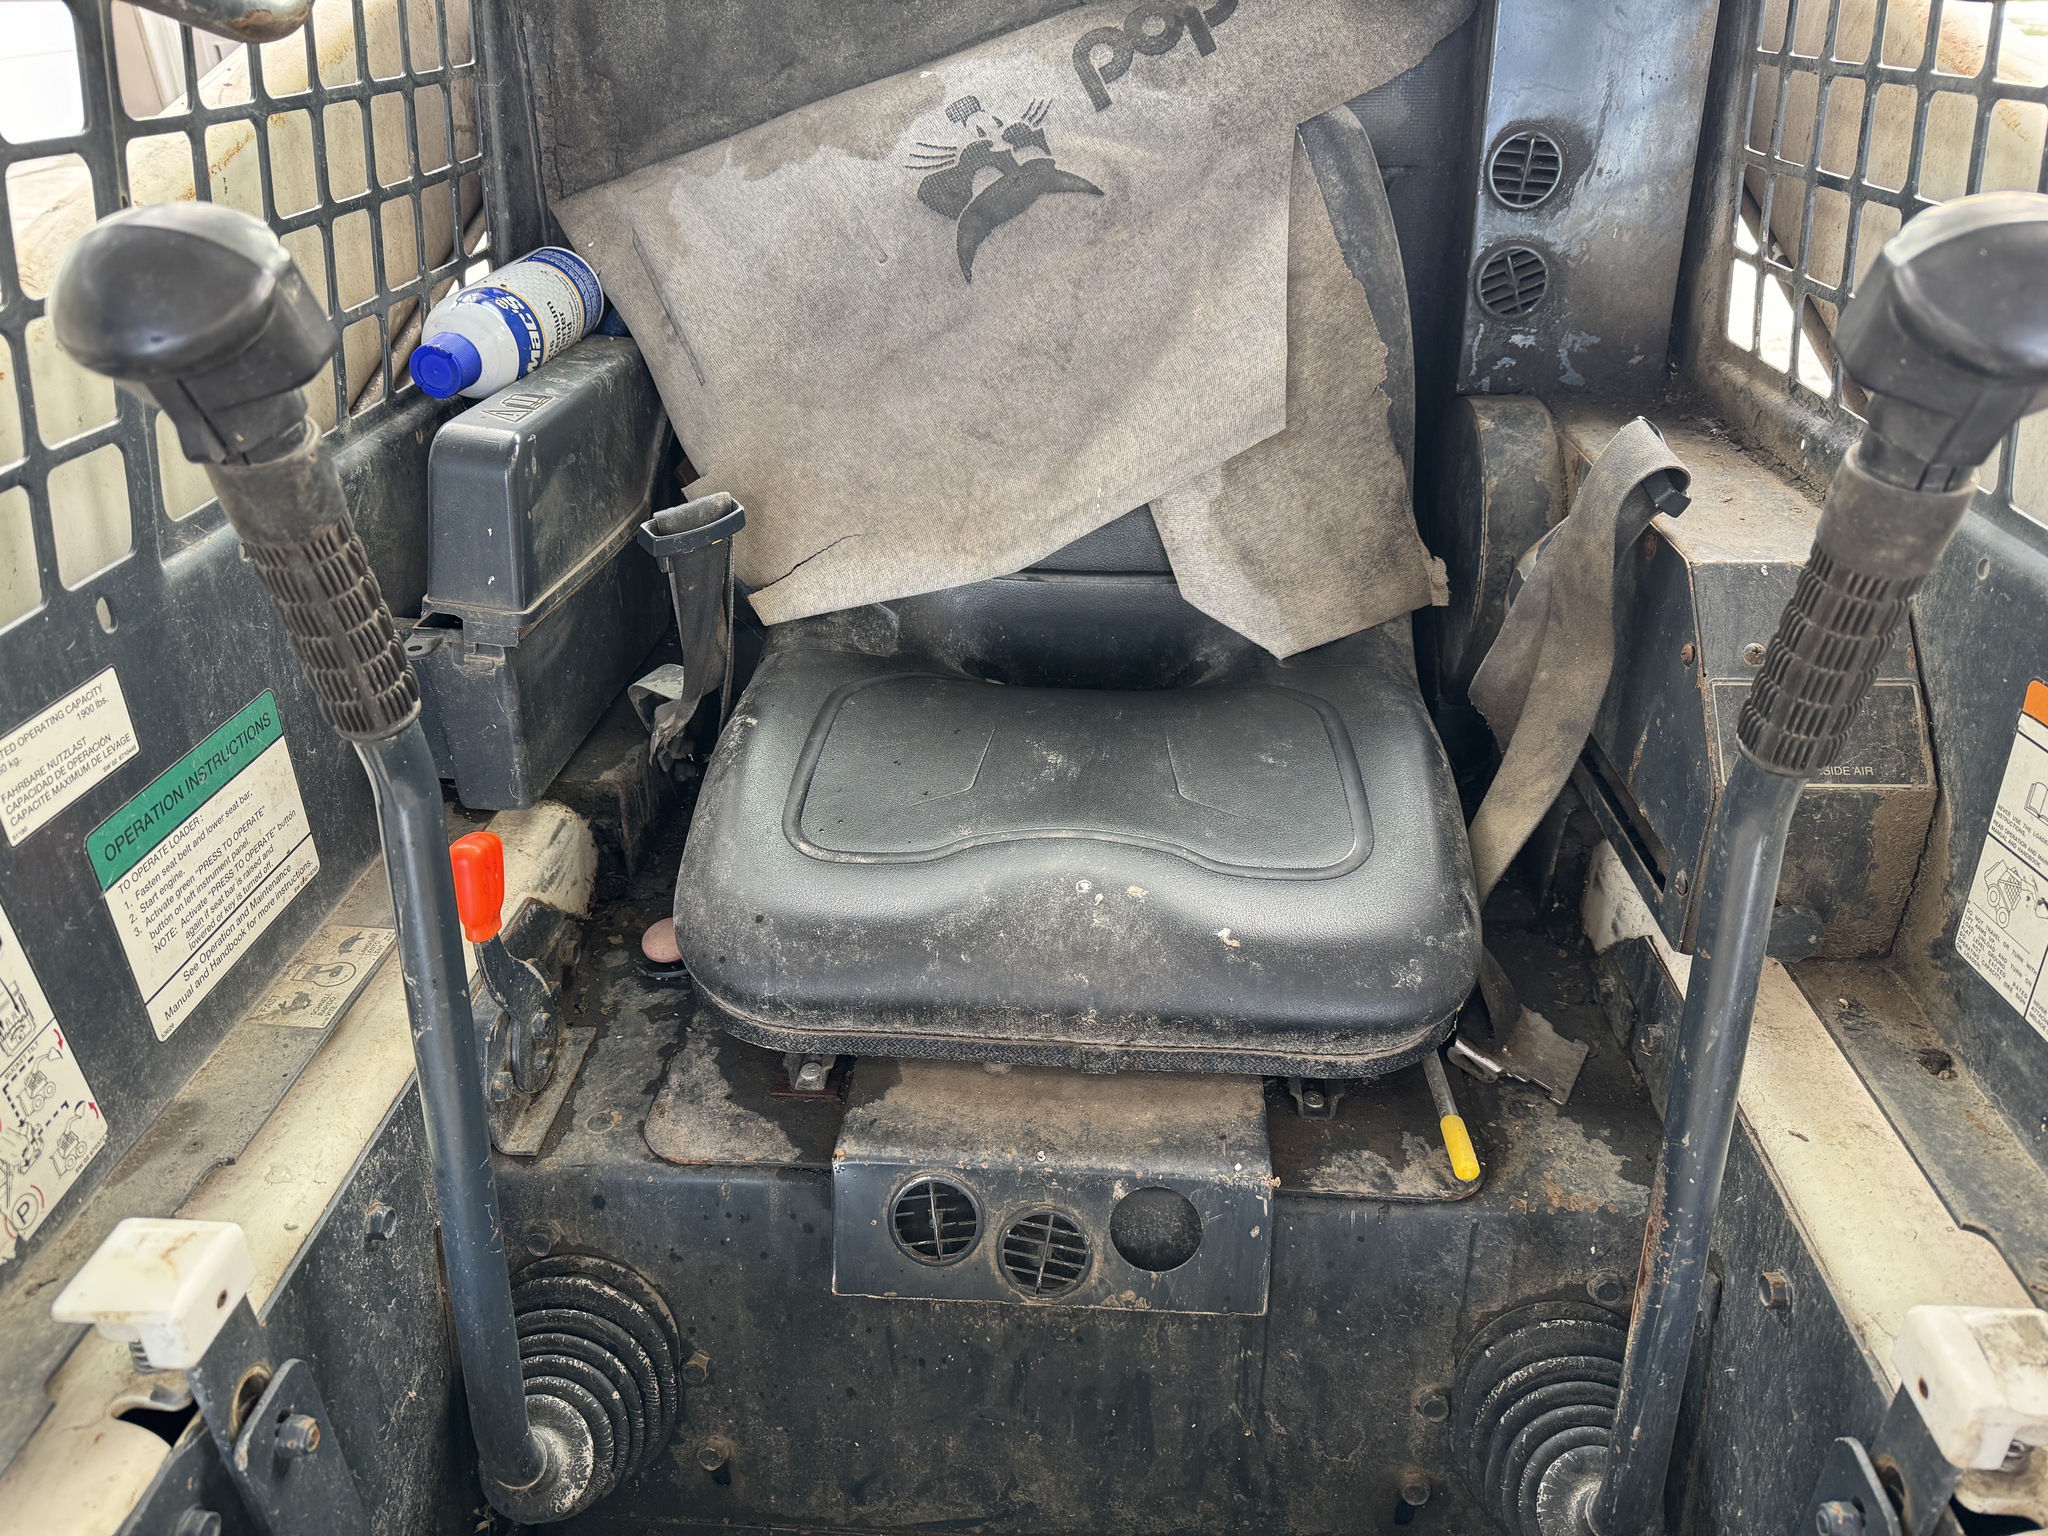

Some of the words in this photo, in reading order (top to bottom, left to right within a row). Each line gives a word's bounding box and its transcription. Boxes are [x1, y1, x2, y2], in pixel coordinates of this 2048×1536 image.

[18, 709, 64, 747] OPERATING
[66, 684, 103, 714] CAPACITY
[77, 704, 95, 721] 1900
[95, 698, 108, 711] lbs.
[1, 764, 51, 803] FAHRBARE
[48, 736, 87, 771] NUTZLAST
[5, 776, 54, 815] CAPACIDAD
[55, 766, 67, 780] DE
[69, 733, 112, 770] OPERACIÓN
[10, 790, 52, 826] CAPACITÉ
[52, 763, 91, 798] MAXIMUM
[91, 755, 102, 768] DE
[103, 733, 131, 760] LEVAGE
[103, 786, 184, 863] OPERATION
[185, 712, 272, 793] INSTRUCTIONS
[1820, 766, 1851, 776] SIDE
[1853, 766, 1873, 776] AIR
[124, 898, 132, 910] 1.
[135, 872, 161, 900] Fasten
[161, 857, 177, 876] seat
[177, 844, 192, 861] belt
[192, 831, 206, 848] and
[206, 814, 225, 836] lower
[225, 800, 240, 817] seat
[239, 789, 253, 805] bar.
[2023, 824, 2031, 833] THE
[2027, 845, 2037, 855] AND
[119, 880, 131, 895] TO
[131, 845, 169, 884] OPERATE
[129, 912, 137, 924] 2.
[140, 892, 158, 914] Start
[159, 868, 186, 896] engine.
[134, 926, 142, 937] 3.
[144, 895, 175, 927] Activate
[176, 876, 195, 899] green
[222, 838, 233, 851] TO
[149, 912, 174, 940] button
[174, 904, 184, 917] on
[184, 891, 196, 907] left
[196, 857, 231, 895] instrument
[232, 838, 251, 863] panel.
[154, 927, 178, 954] NOTE:
[180, 897, 208, 928] Activate
[235, 860, 245, 873] TO
[277, 809, 297, 832] button
[185, 917, 205, 940] again
[210, 896, 225, 914] seat
[225, 884, 236, 899] bar
[236, 877, 243, 887] is
[243, 858, 262, 880] raised
[262, 845, 274, 861] and
[182, 960, 199, 982] See
[199, 923, 236, 965] Operation
[235, 908, 250, 926] and
[249, 864, 291, 911] Maintenance
[188, 919, 216, 951] lowered
[216, 912, 224, 922] or
[224, 899, 236, 915] key
[236, 892, 243, 902] is
[243, 870, 263, 895] turned
[263, 860, 274, 874] off.
[1986, 926, 2000, 942] TRAVEL
[164, 983, 194, 1021] Manual
[194, 968, 210, 988] and
[209, 928, 247, 972] Handbook
[247, 916, 257, 931] for
[257, 898, 275, 920] more
[275, 858, 314, 900] instructions.
[1982, 960, 2001, 981] CAPACITY
[1998, 952, 2008, 964] AND
[2010, 964, 2022, 978] TURN
[2012, 981, 2028, 999] RATED
[5, 1056, 27, 1079] BUCKET
[17, 1202, 30, 1224] P
